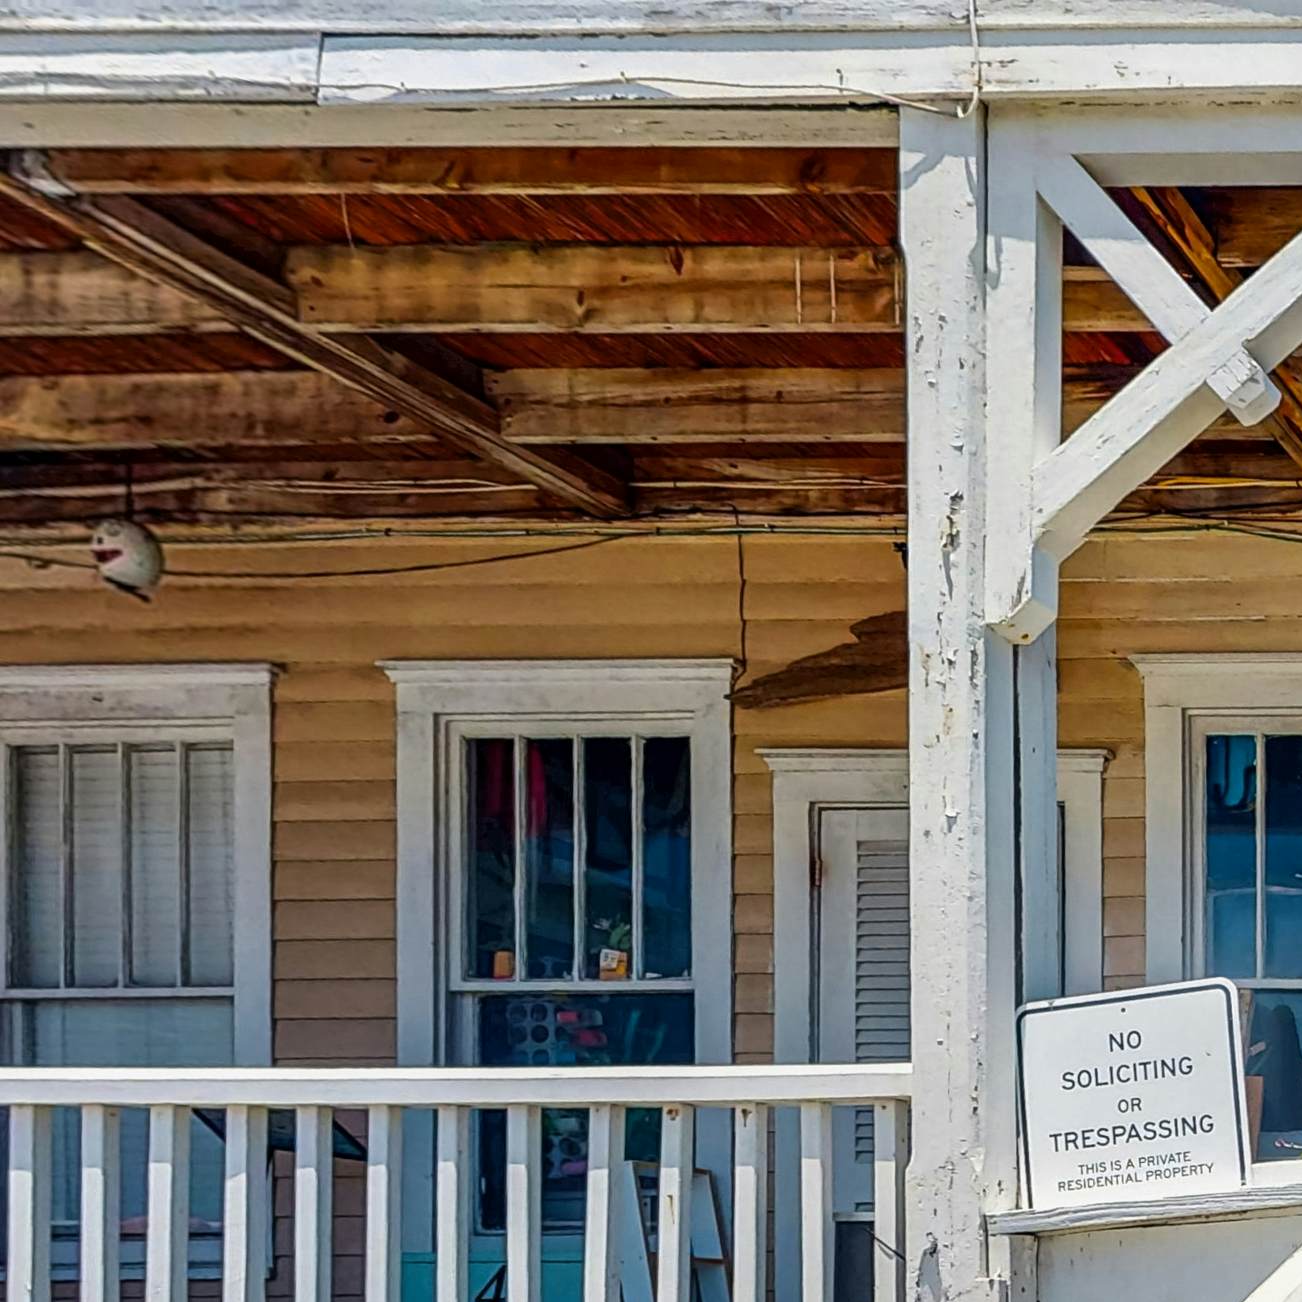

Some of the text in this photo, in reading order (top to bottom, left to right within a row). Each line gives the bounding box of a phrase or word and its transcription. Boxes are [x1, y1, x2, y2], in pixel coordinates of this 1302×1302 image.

[1109, 1030, 1142, 1052] NO
[1062, 1056, 1193, 1090] SOLICITING
[1117, 1098, 1142, 1113] OR
[1049, 1114, 1215, 1152] TRESPASSING
[1078, 1151, 1192, 1175] THIS IS A PRIVATE
[1058, 1163, 1214, 1192] RESIDENTIAL PROPERTY
